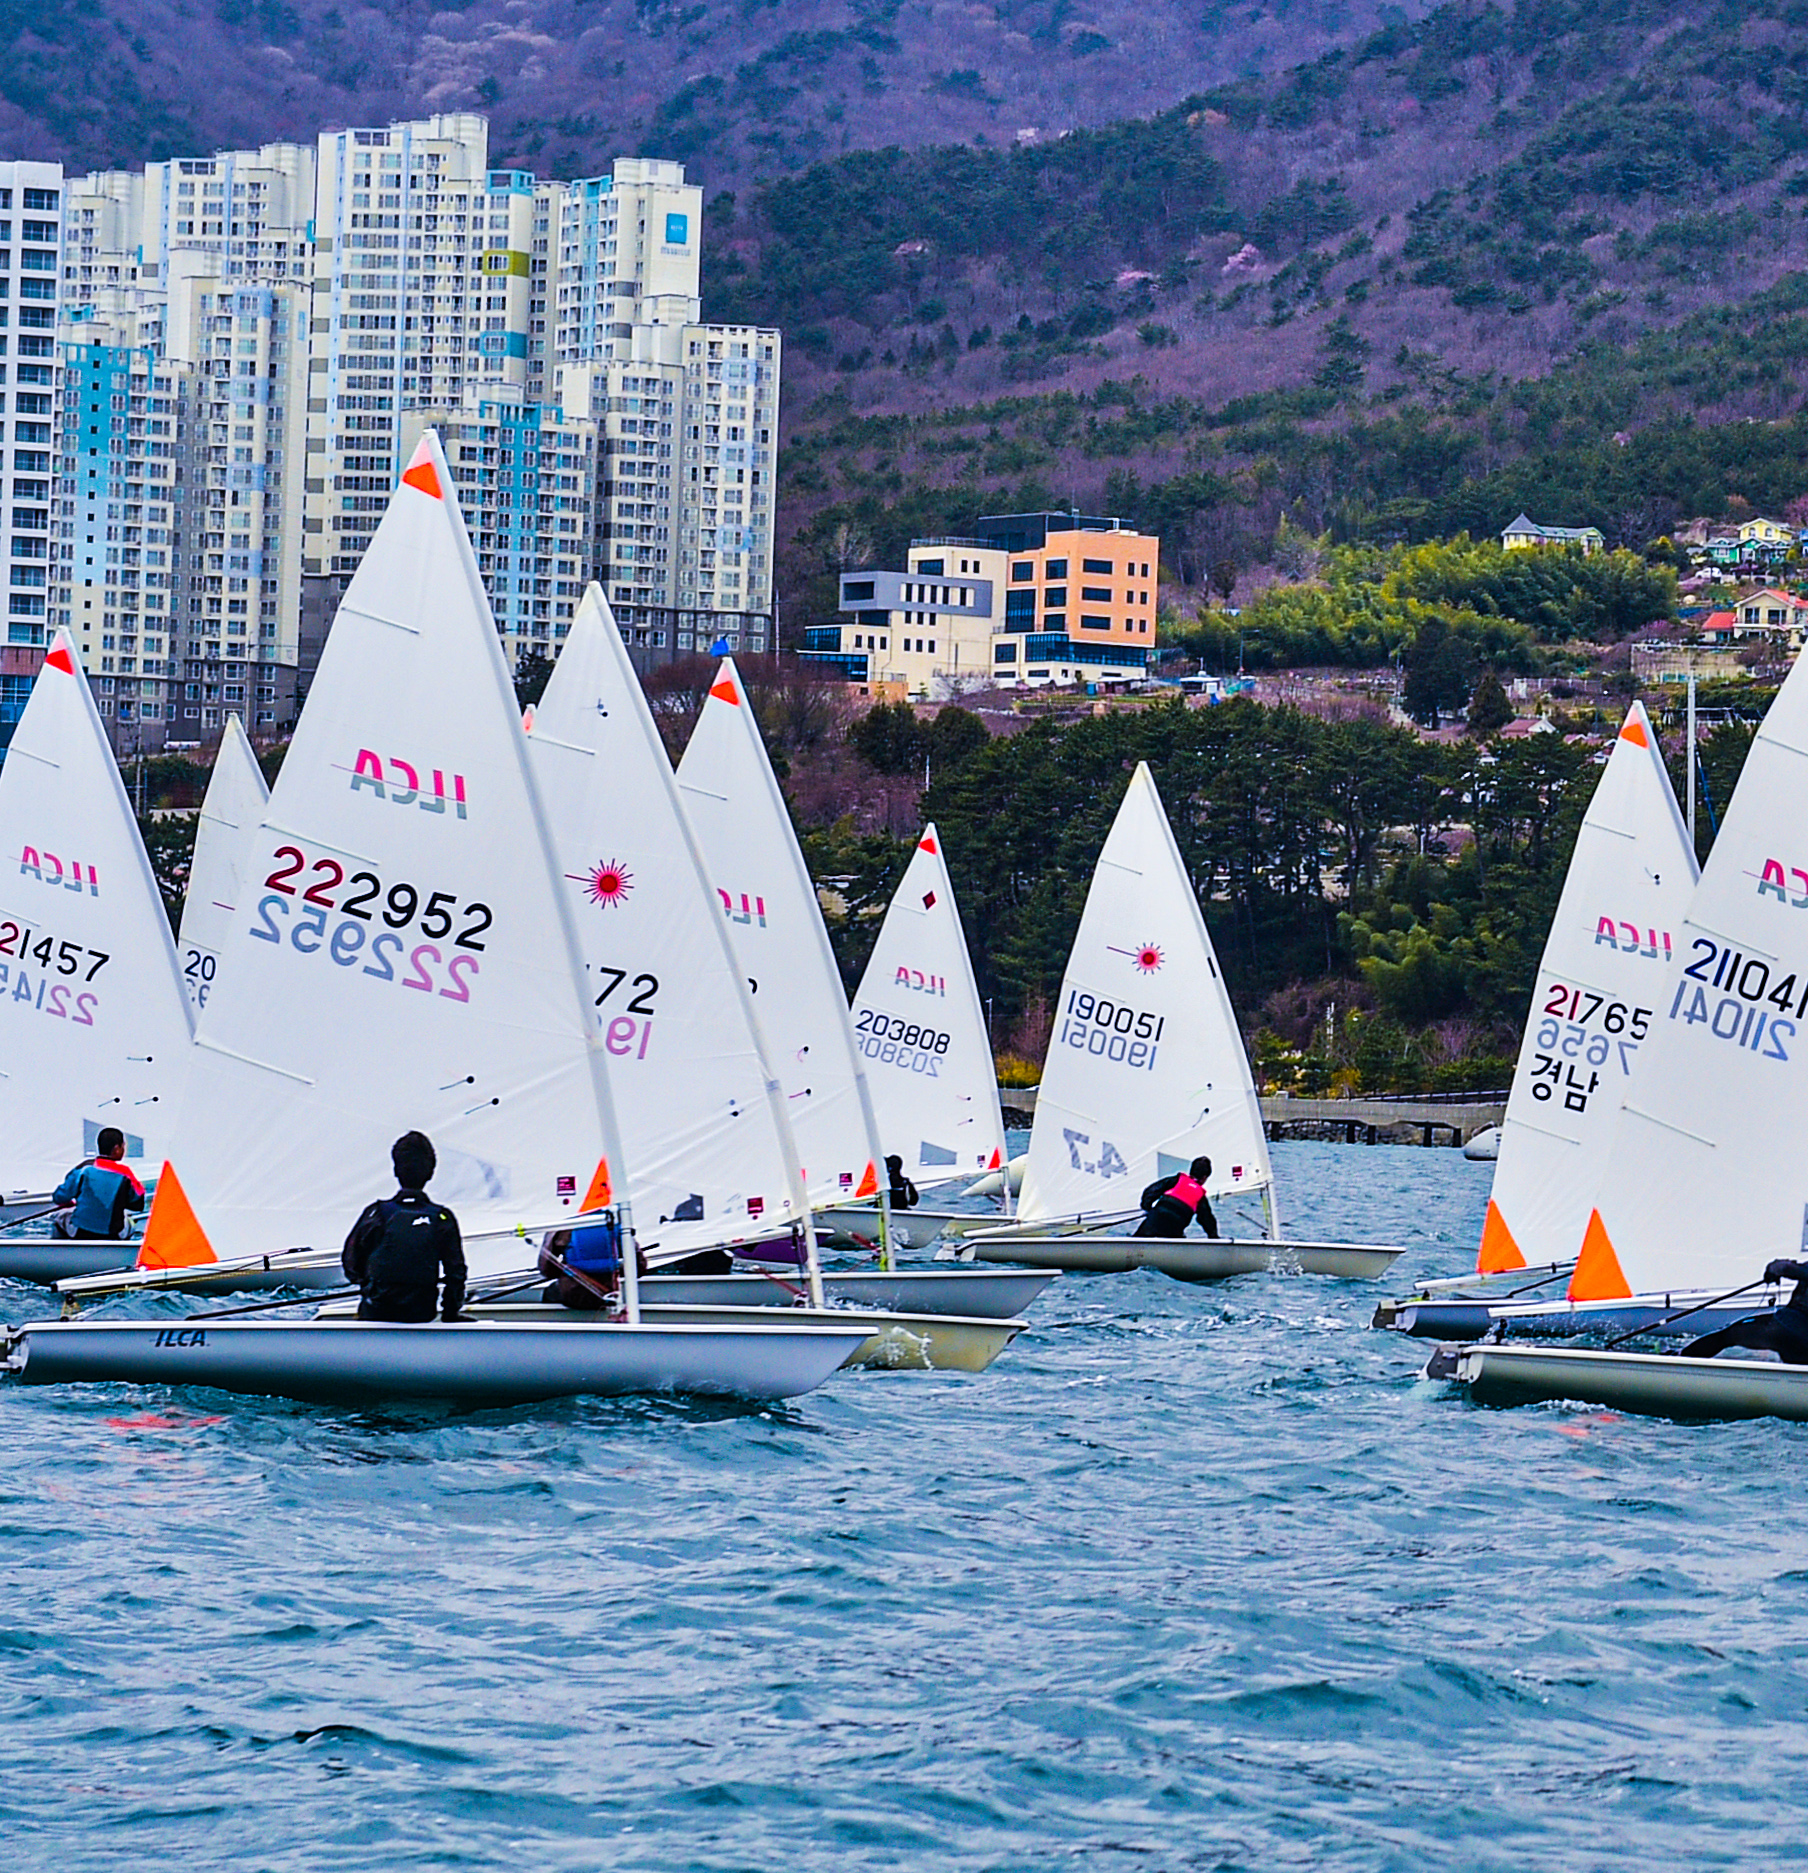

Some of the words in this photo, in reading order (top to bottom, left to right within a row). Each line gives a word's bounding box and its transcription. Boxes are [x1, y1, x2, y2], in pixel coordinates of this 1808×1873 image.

[265, 845, 494, 952] 222952
[585, 963, 660, 1016] 72
[1067, 990, 1165, 1042] 190051
[1543, 984, 1653, 1040] 21765
[855, 1009, 951, 1054] 203808
[1530, 1053, 1600, 1113] 경남
[155, 1328, 207, 1348] ILCA
